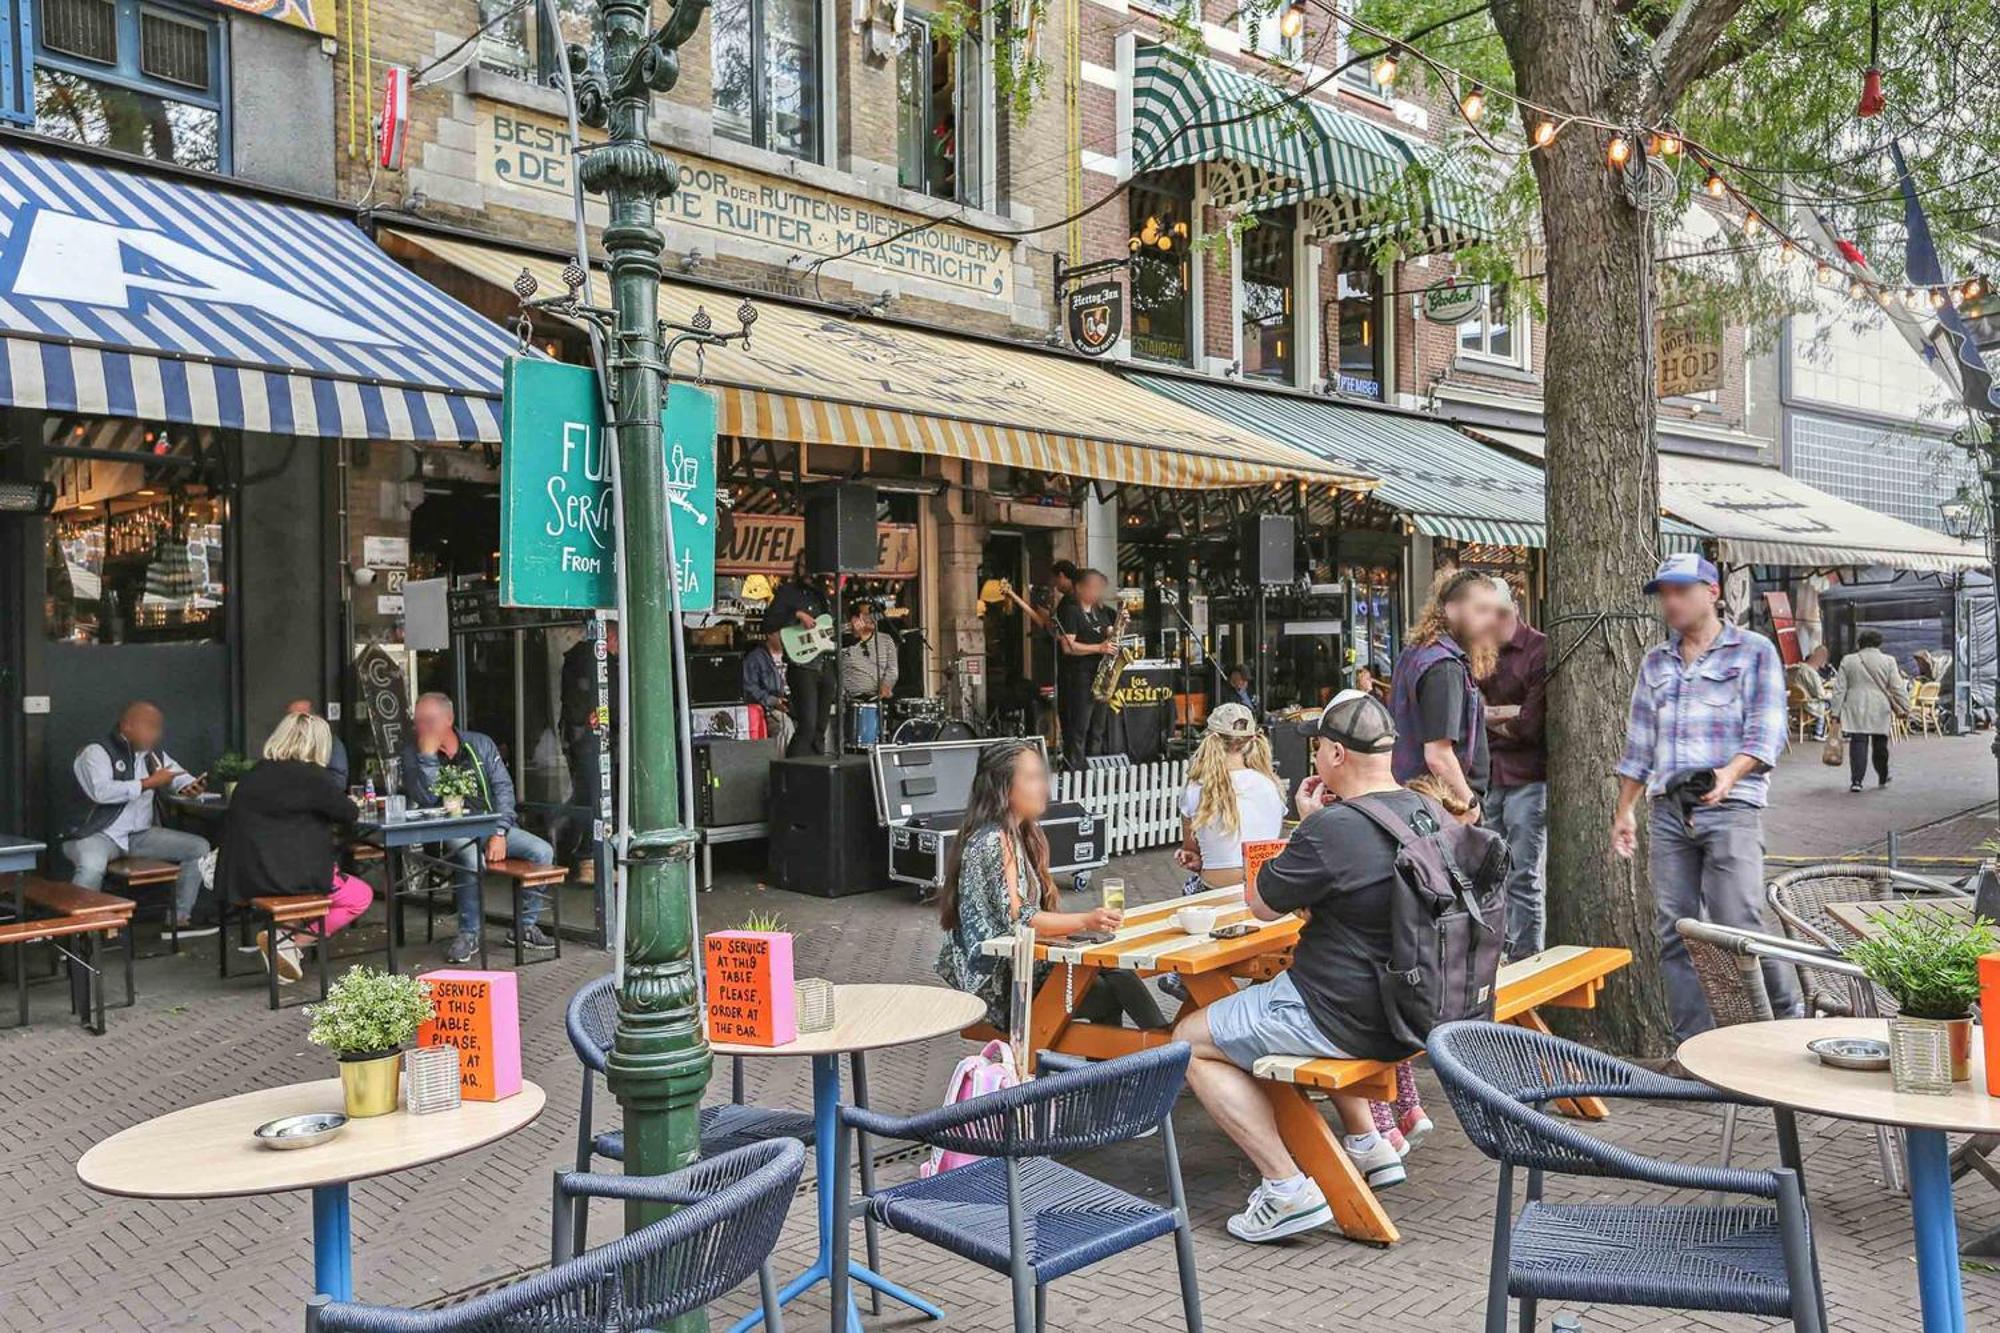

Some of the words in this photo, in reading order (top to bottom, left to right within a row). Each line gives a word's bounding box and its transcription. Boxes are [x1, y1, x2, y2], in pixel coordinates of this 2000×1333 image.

[519, 152, 565, 188] DE
[716, 200, 813, 246] RUITER
[836, 231, 986, 286] MAASTRICHT
[731, 187, 757, 204] DER
[760, 185, 851, 224] RUTTENS
[856, 210, 1003, 262] BIERBROUWERY
[1101, 288, 1119, 301] Jan
[1661, 351, 1719, 382] HOP
[562, 547, 600, 573] FROM
[709, 941, 722, 951] NO
[728, 941, 768, 955] SERVICE
[717, 957, 728, 967] AT
[438, 982, 486, 999] SERVICE
[448, 1000, 476, 1015] THIS
[711, 1005, 743, 1019] ORDER
[747, 1010, 758, 1021] AT
[715, 1022, 732, 1034] THE
[467, 1055, 480, 1068] AT
[461, 1073, 482, 1088] AR.
